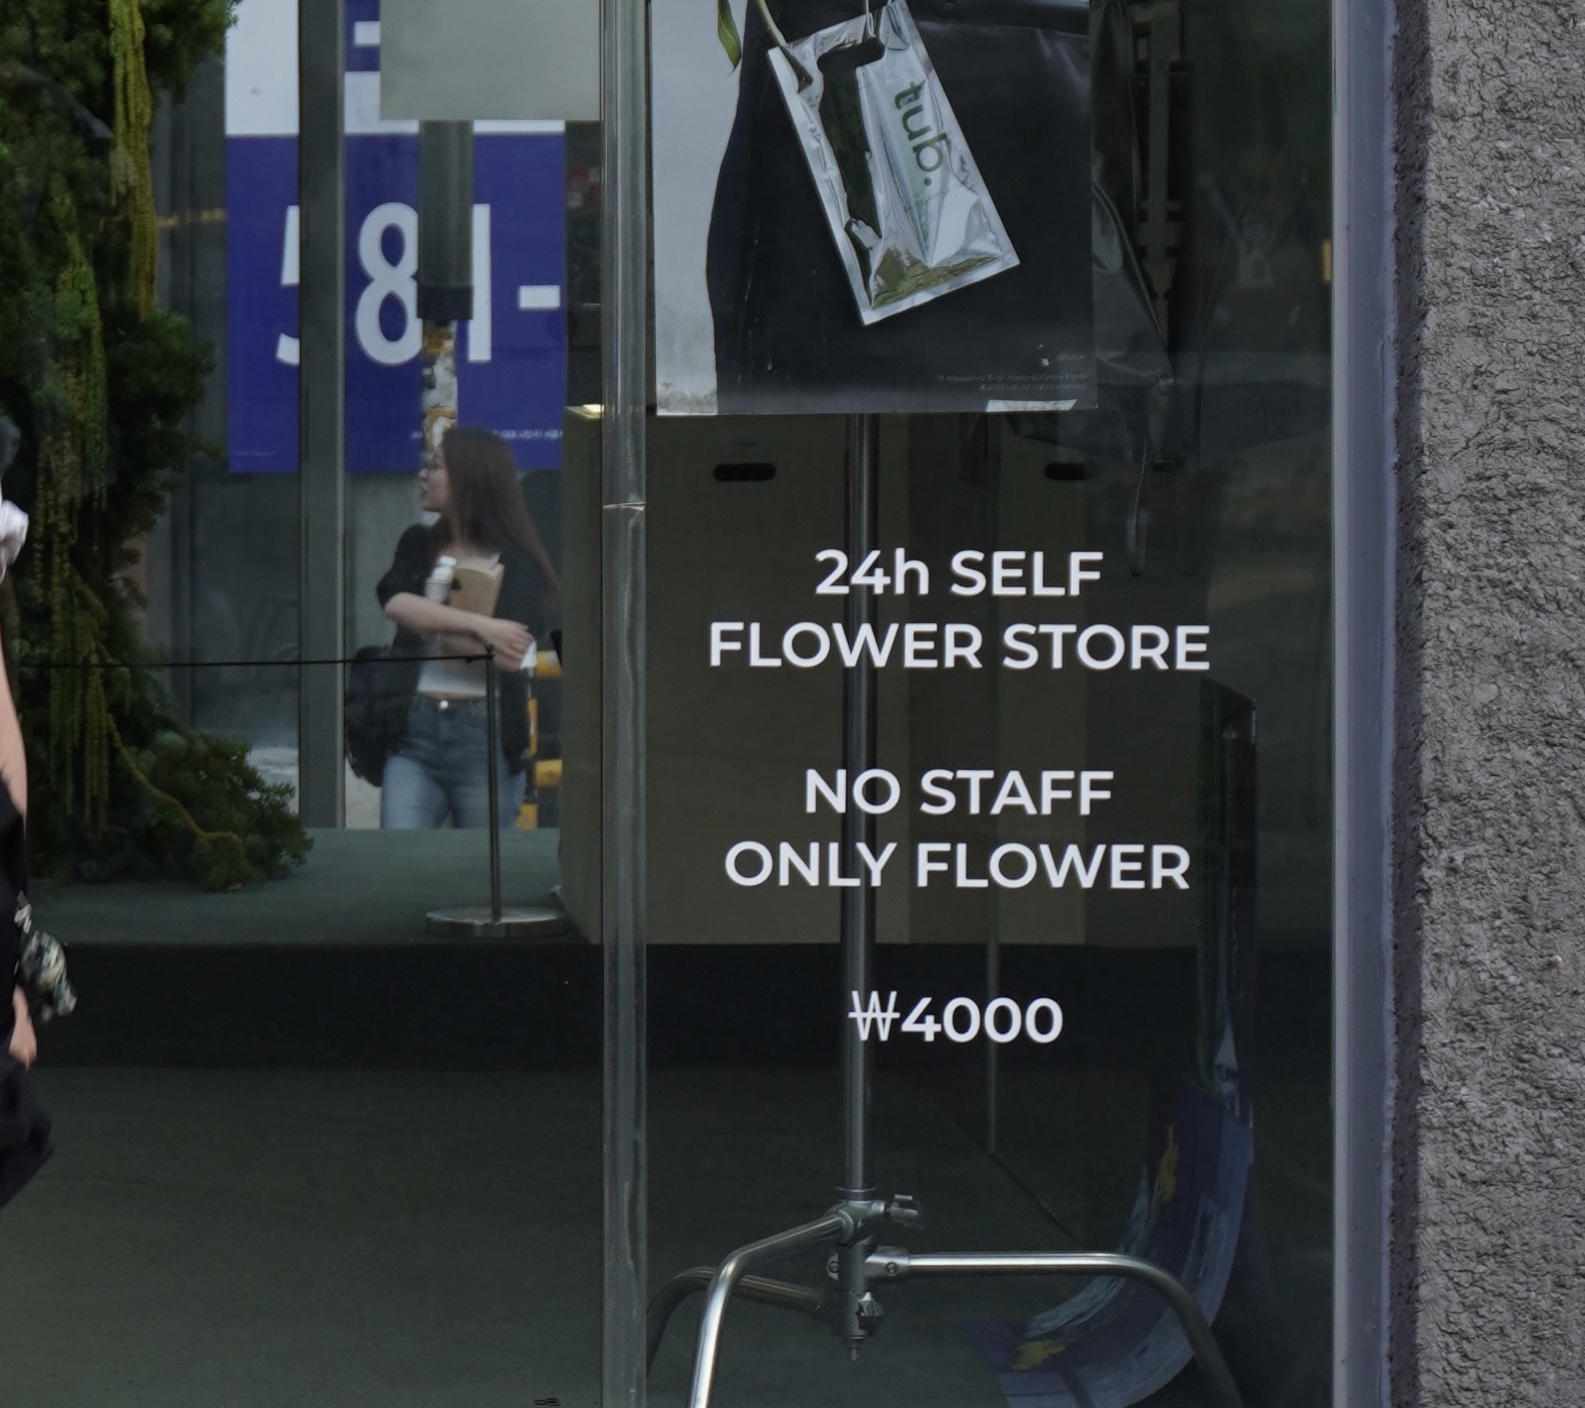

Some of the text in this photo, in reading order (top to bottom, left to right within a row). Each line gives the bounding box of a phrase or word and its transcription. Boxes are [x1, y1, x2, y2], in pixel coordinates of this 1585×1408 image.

[894, 79, 949, 187] tub.
[815, 547, 1105, 597] 24h SELF
[709, 620, 1211, 672] FLOWER STORE
[804, 767, 1115, 817] NO STAFF
[723, 839, 1191, 891] ONLY FLOWER
[847, 989, 1064, 1045] ₩4000
